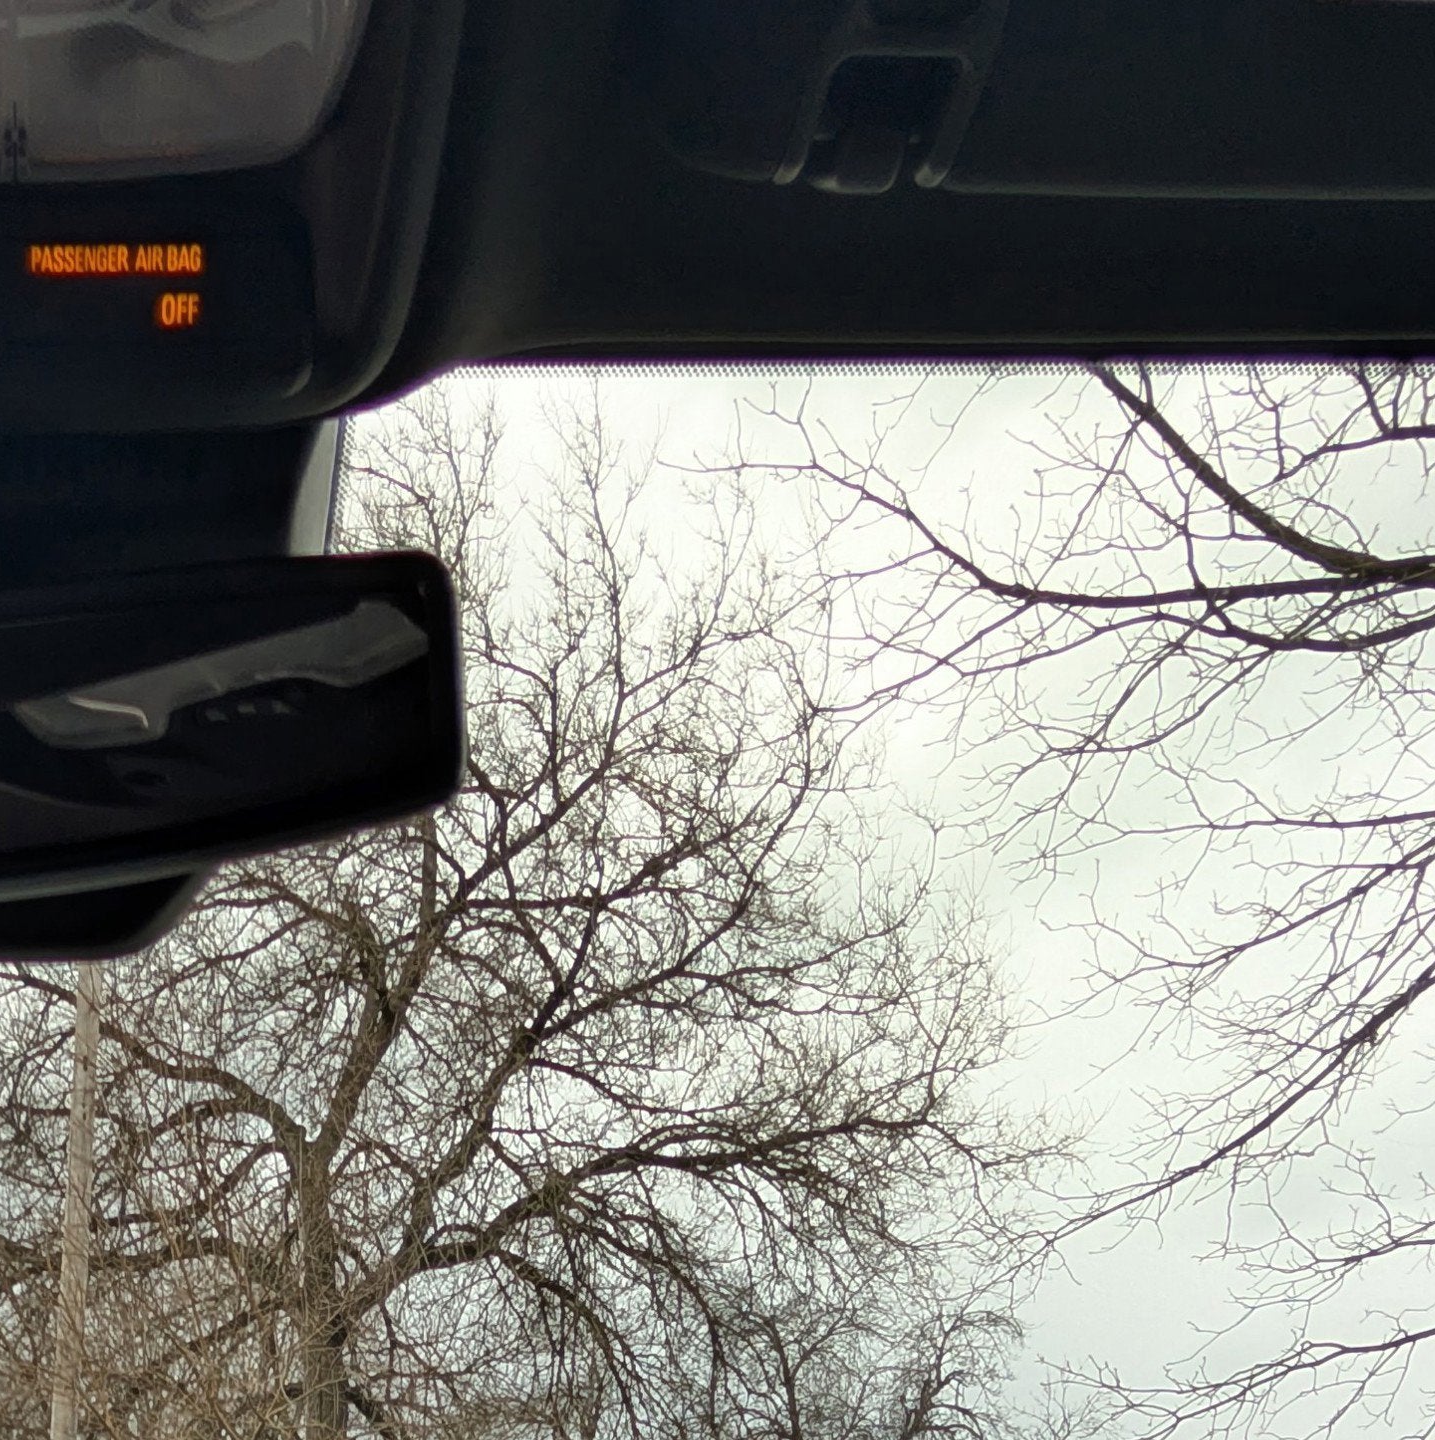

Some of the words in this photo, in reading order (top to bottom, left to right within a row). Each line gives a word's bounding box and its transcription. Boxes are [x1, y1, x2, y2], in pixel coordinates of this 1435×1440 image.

[29, 244, 130, 274] PASSENGER
[133, 244, 165, 274] AIR
[166, 244, 202, 274] BAG
[160, 293, 200, 326] OFF
